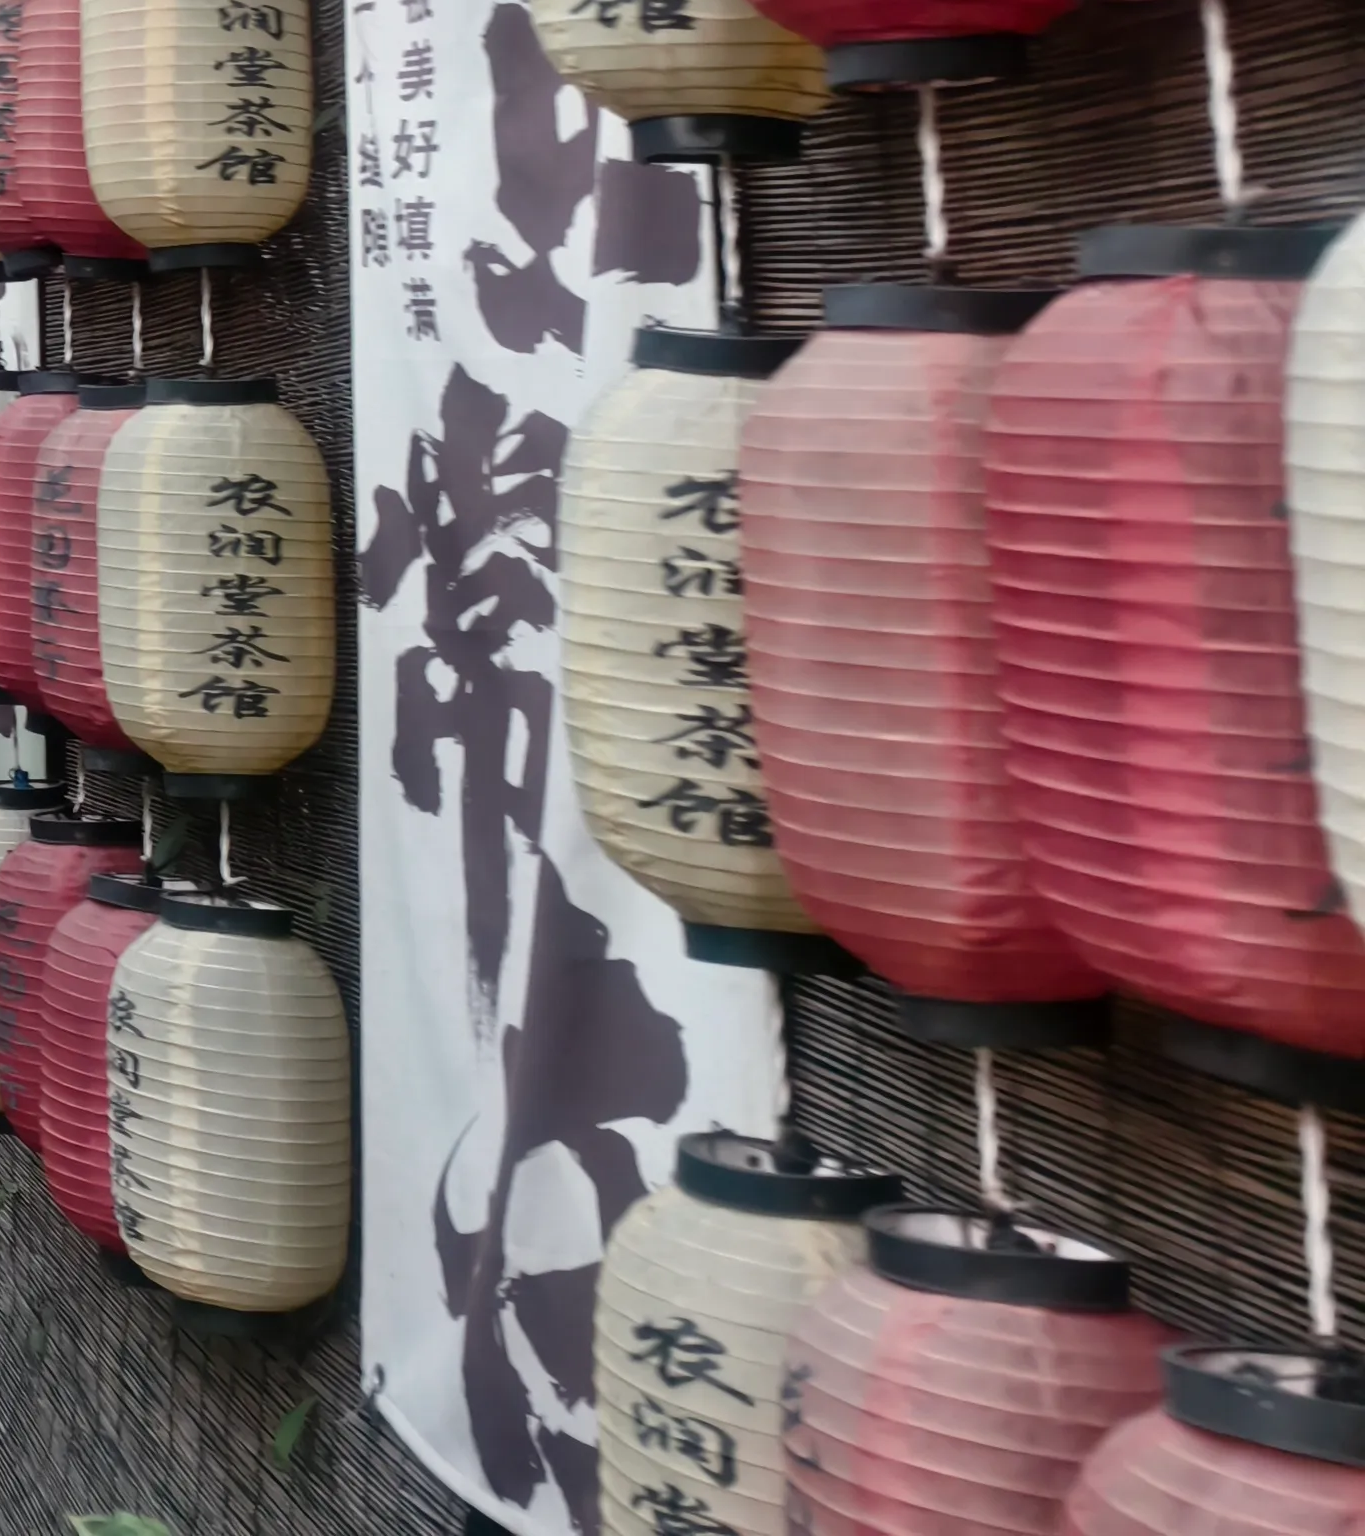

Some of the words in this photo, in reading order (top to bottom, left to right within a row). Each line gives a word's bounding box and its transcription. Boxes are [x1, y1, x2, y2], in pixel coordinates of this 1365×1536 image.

[178, 474, 294, 719] 农润堂茶馆
